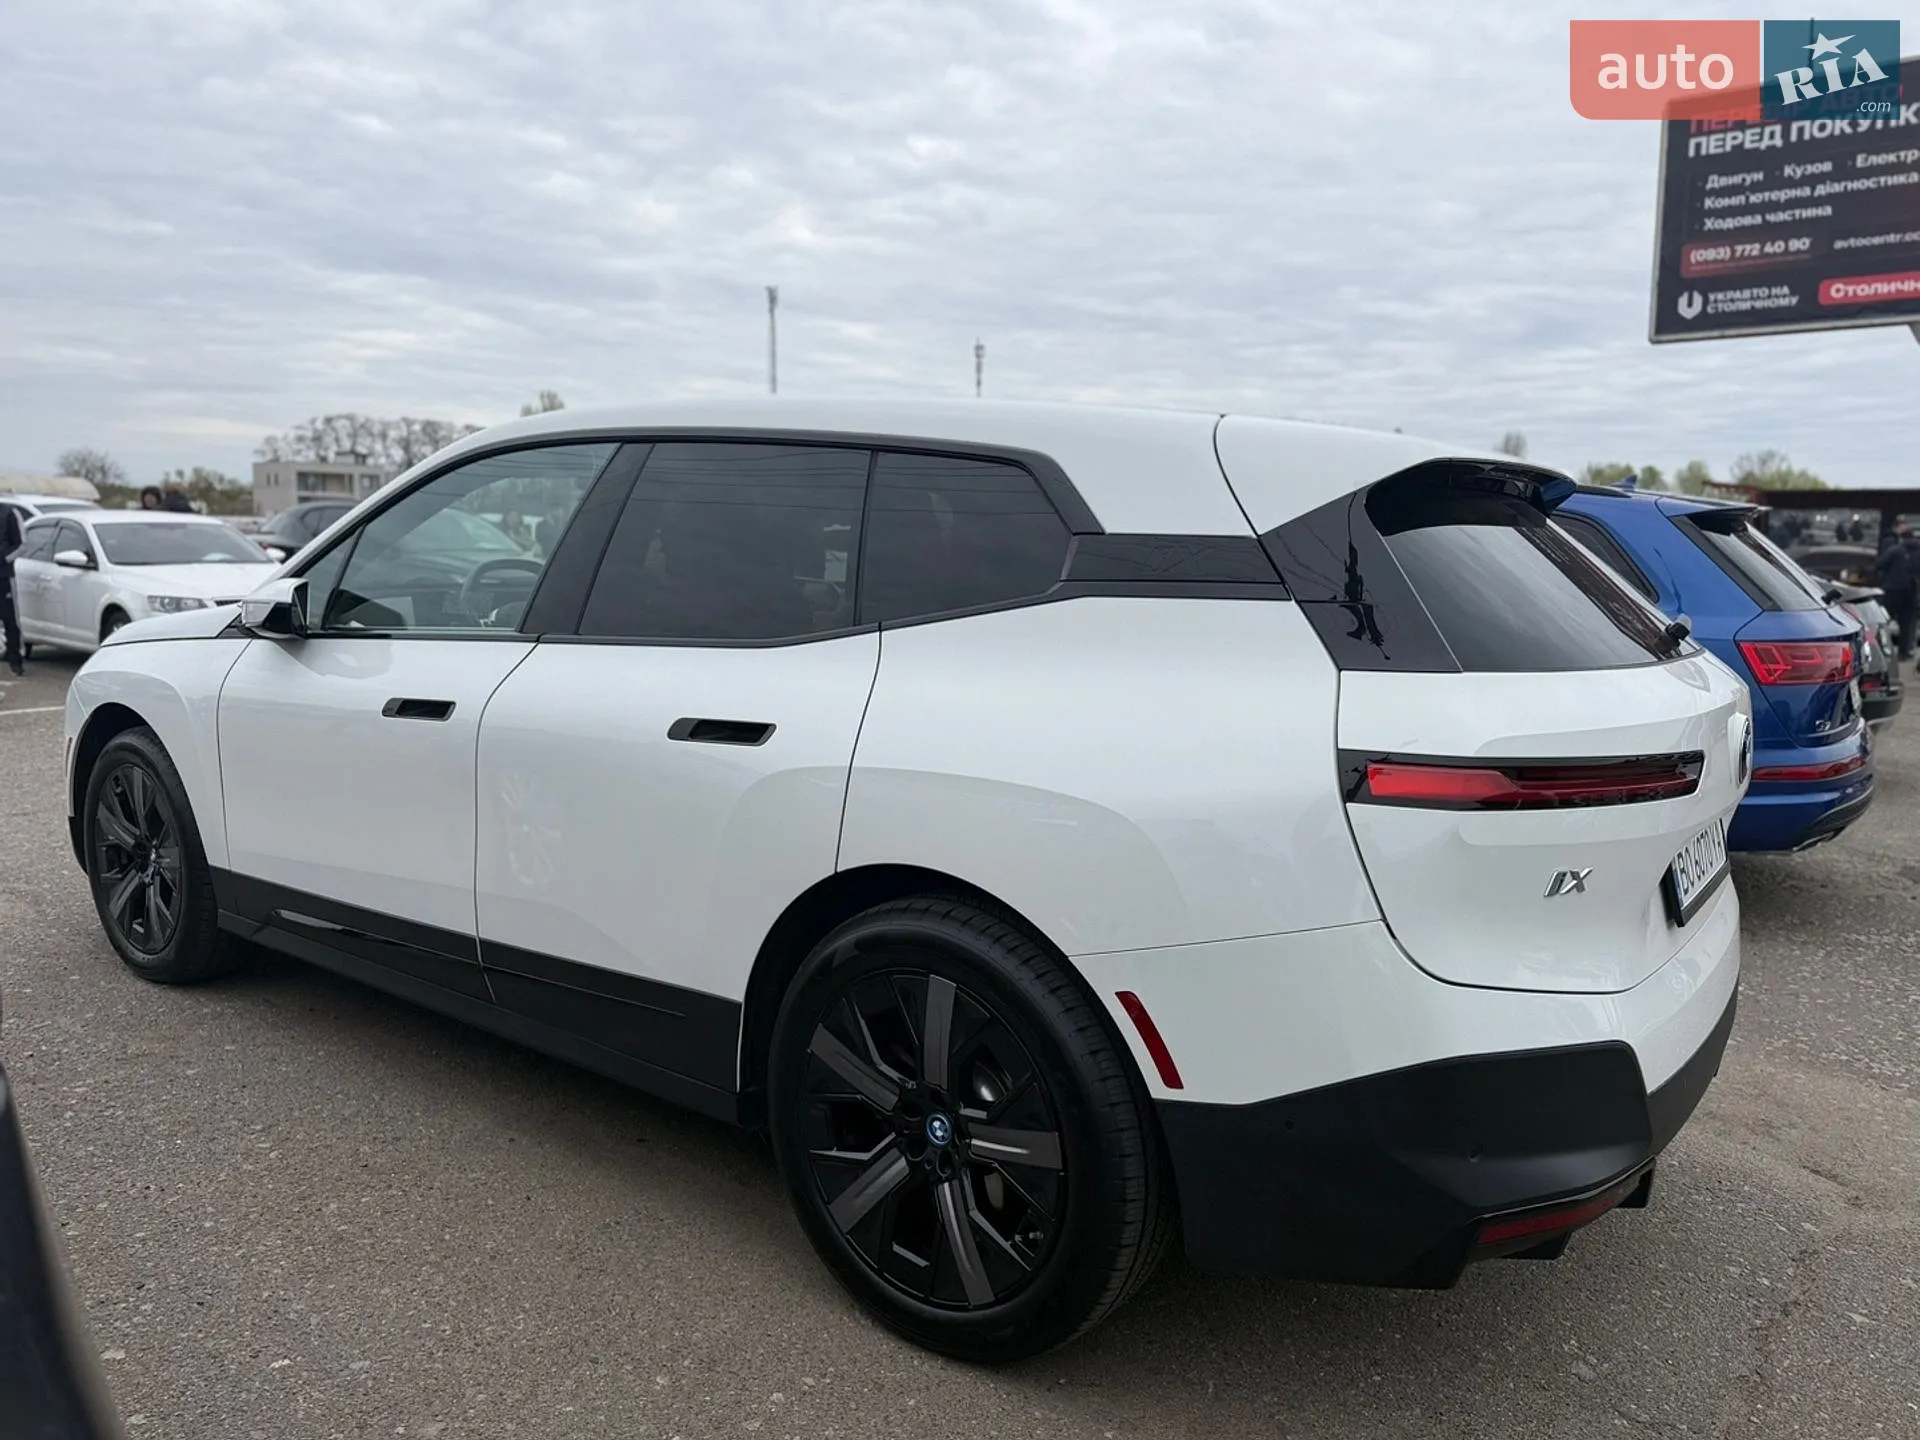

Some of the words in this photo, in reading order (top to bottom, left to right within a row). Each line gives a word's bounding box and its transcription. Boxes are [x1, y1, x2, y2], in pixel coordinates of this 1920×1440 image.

[1688, 123, 1784, 158] ПЕРЕД
[1705, 170, 1764, 190] Двигун
[1783, 160, 1832, 179] Кузов
[1855, 148, 1920, 168] Електр
[1814, 171, 1919, 197] діагностика
[1703, 213, 1762, 231] Ходова
[1765, 204, 1832, 223] частина
[1770, 285, 1790, 296] НА
